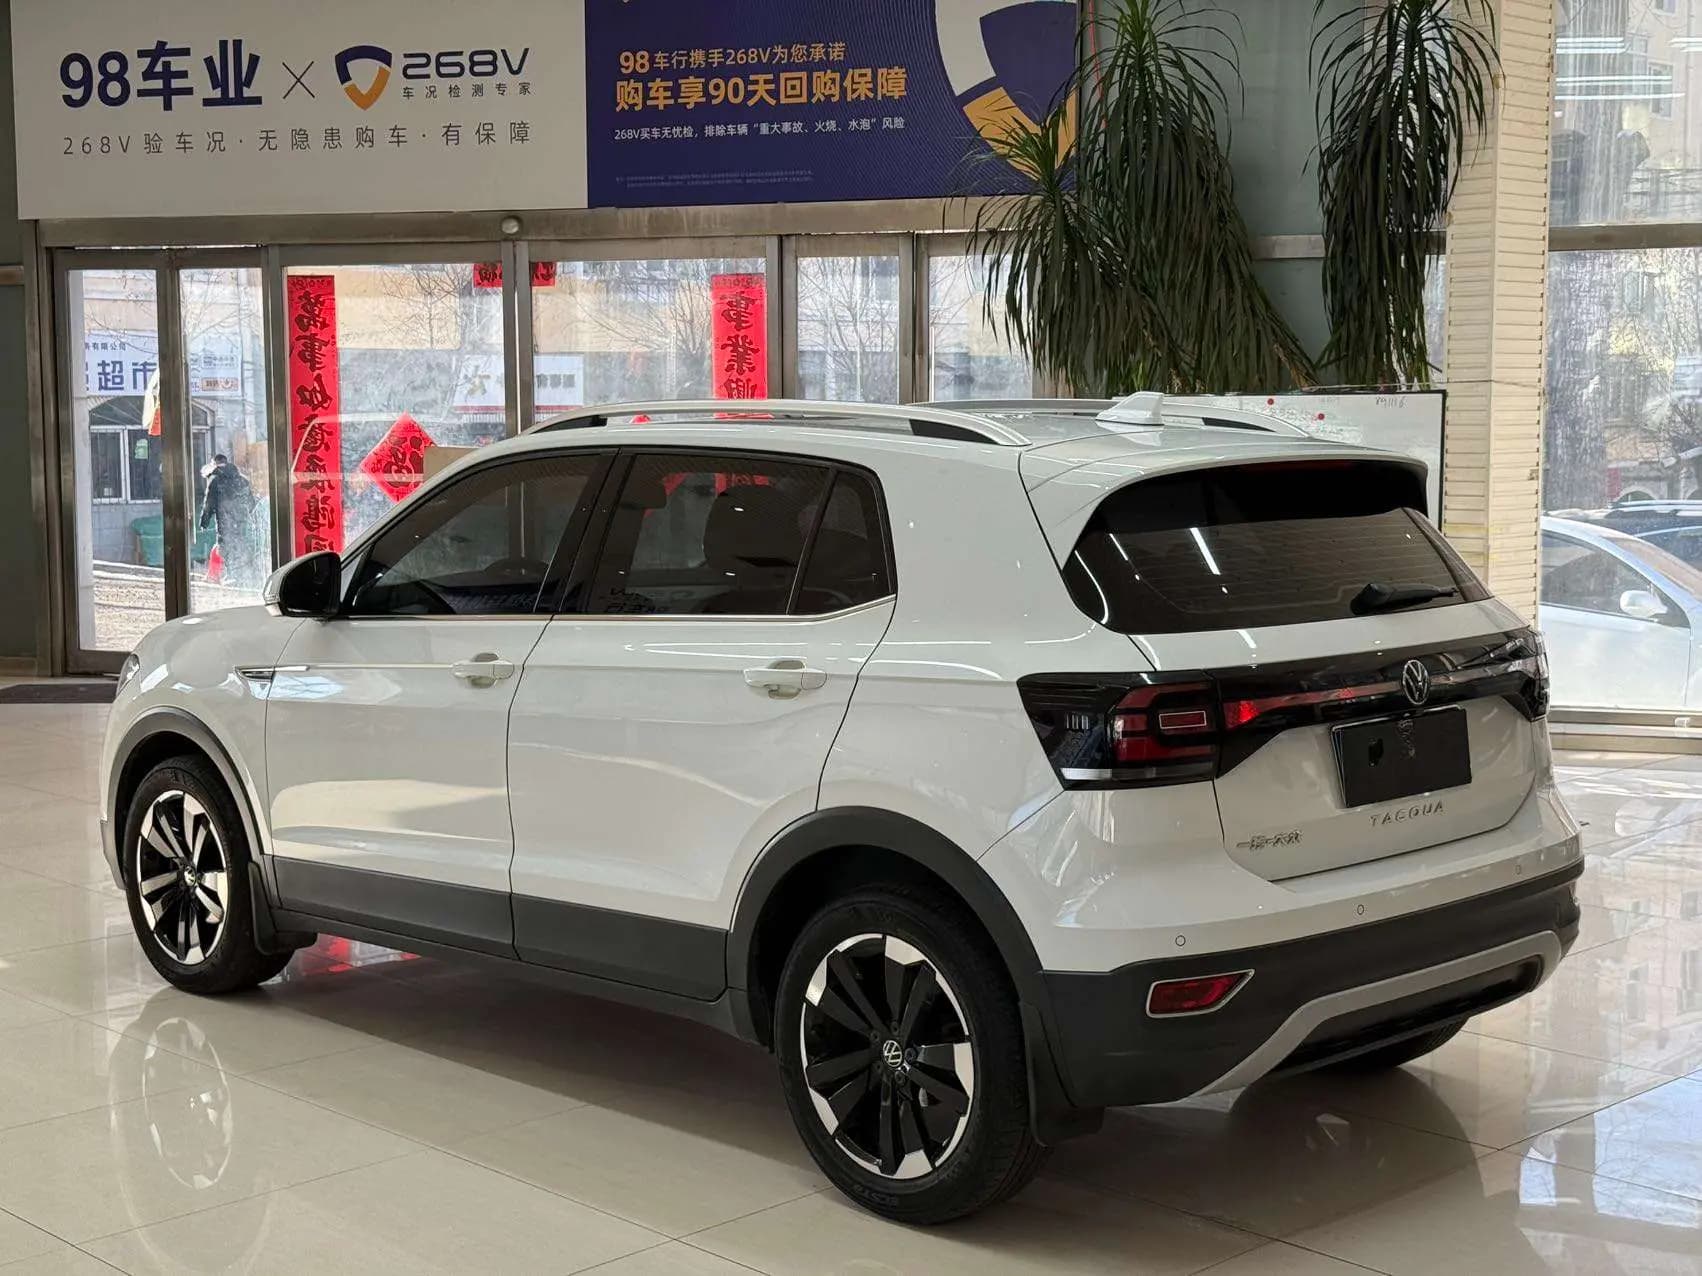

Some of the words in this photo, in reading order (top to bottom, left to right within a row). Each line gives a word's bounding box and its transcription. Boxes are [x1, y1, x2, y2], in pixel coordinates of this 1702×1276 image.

[60, 39, 263, 111] 98车业
[402, 47, 530, 79] 268V
[402, 82, 532, 100] 车况检测专家
[615, 66, 908, 112] 购车享90天回购保障
[85, 359, 158, 391] 超市
